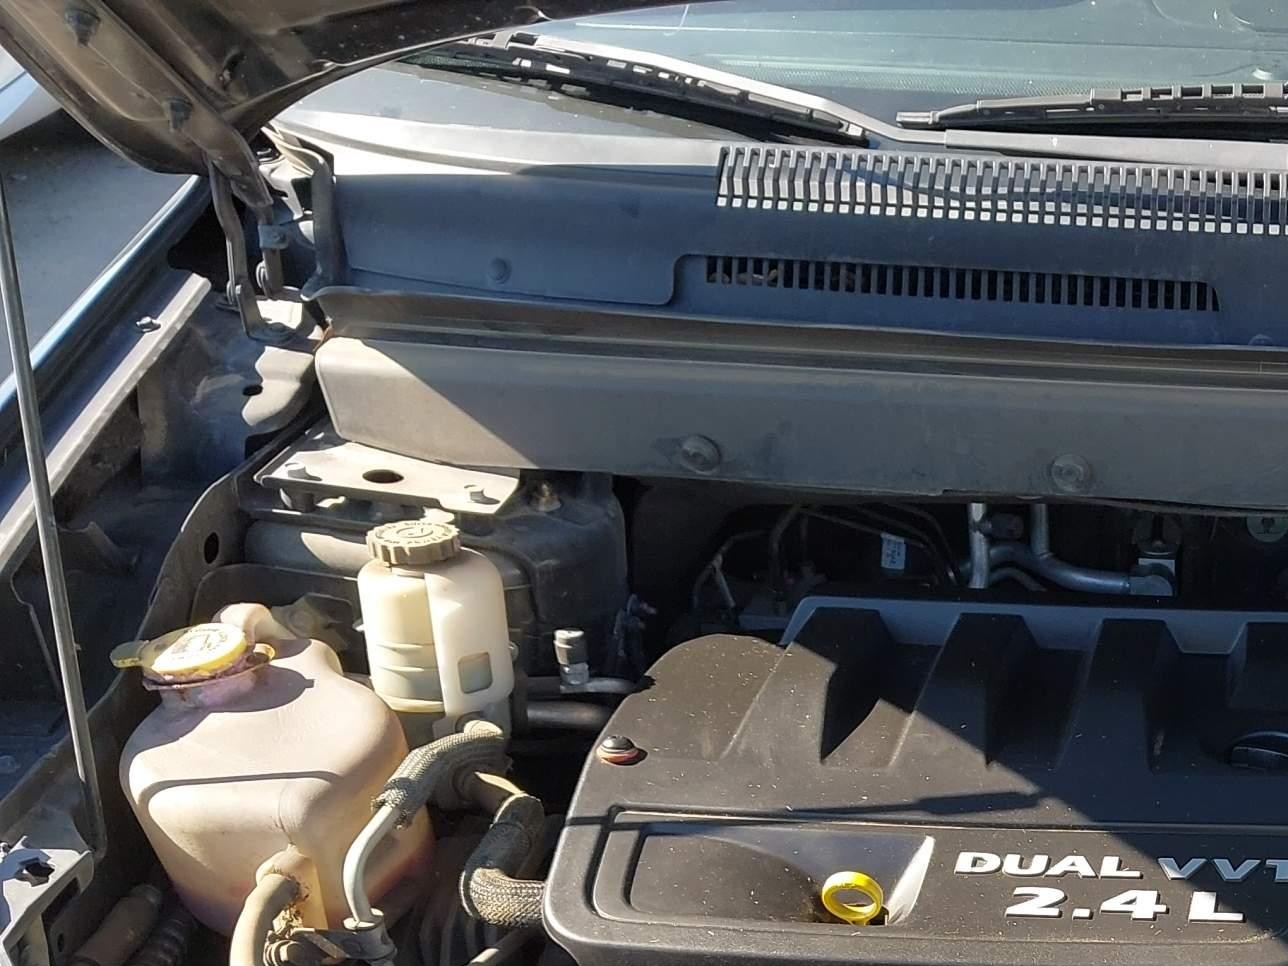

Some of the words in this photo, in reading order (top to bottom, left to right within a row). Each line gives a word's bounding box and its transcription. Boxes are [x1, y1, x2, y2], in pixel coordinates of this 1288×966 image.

[954, 852, 1142, 879] DUAL
[1004, 887, 1169, 922] 2.4
[1188, 891, 1245, 923] L
